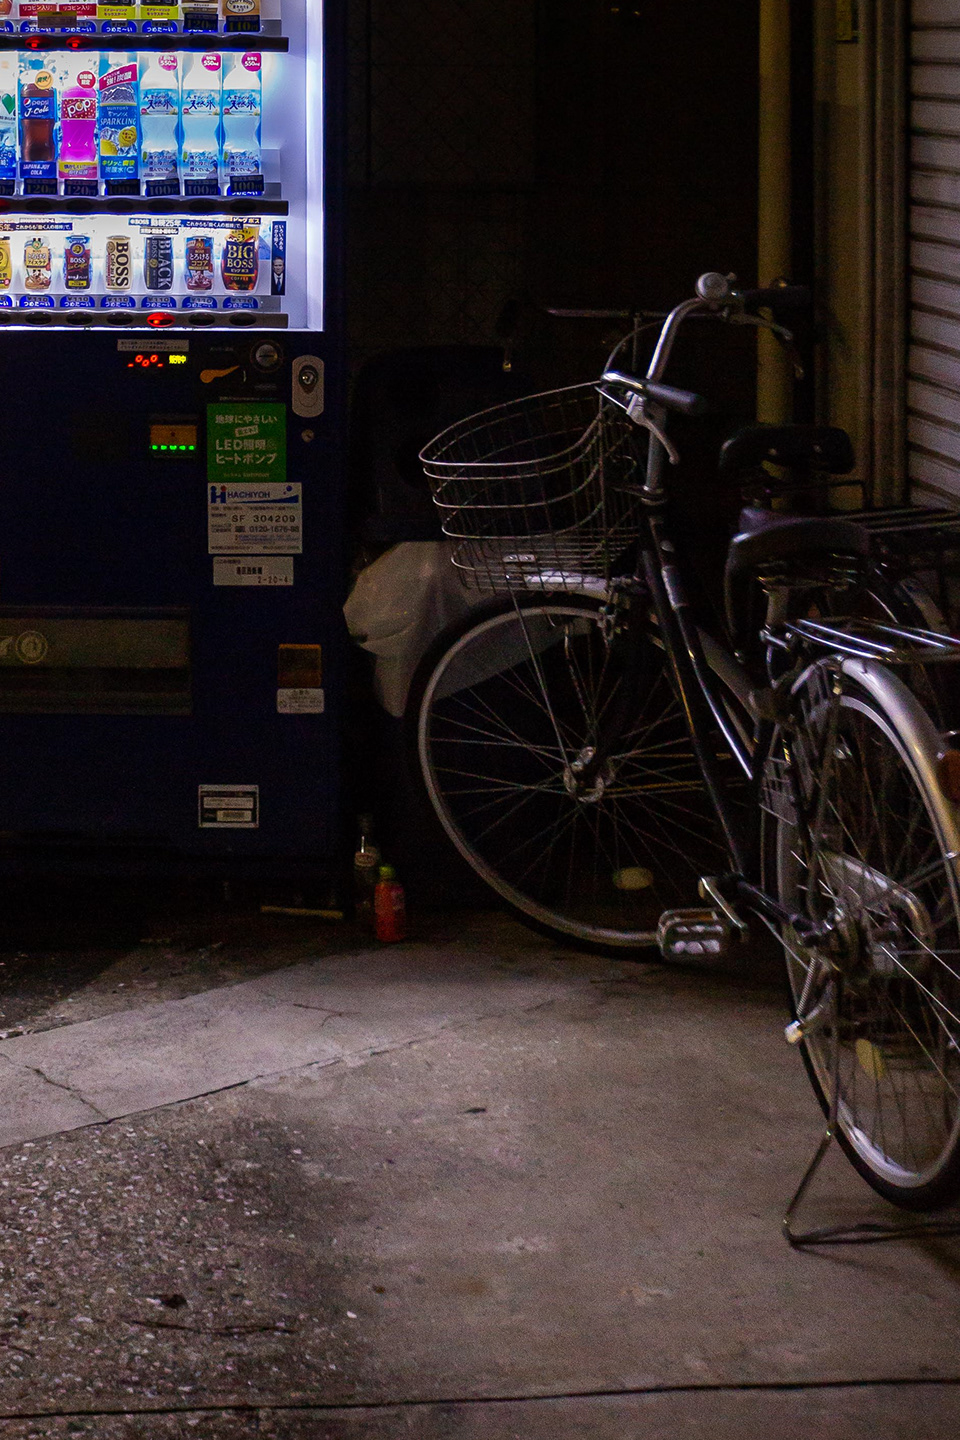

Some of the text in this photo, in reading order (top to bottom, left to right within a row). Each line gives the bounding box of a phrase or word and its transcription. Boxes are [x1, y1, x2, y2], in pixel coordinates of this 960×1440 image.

[67, 99, 91, 118] pop
[147, 100, 173, 110] 天然水
[188, 100, 214, 110] 天然水
[230, 100, 256, 110] 天然水
[228, 245, 254, 258] BIG
[116, 242, 129, 286] BOSS
[158, 240, 172, 288] BLACK
[227, 260, 254, 268] BOSS
[215, 414, 278, 424] 地球にやさしい
[215, 453, 277, 465] ヒートポンプ
[232, 514, 296, 522] SF 304209
